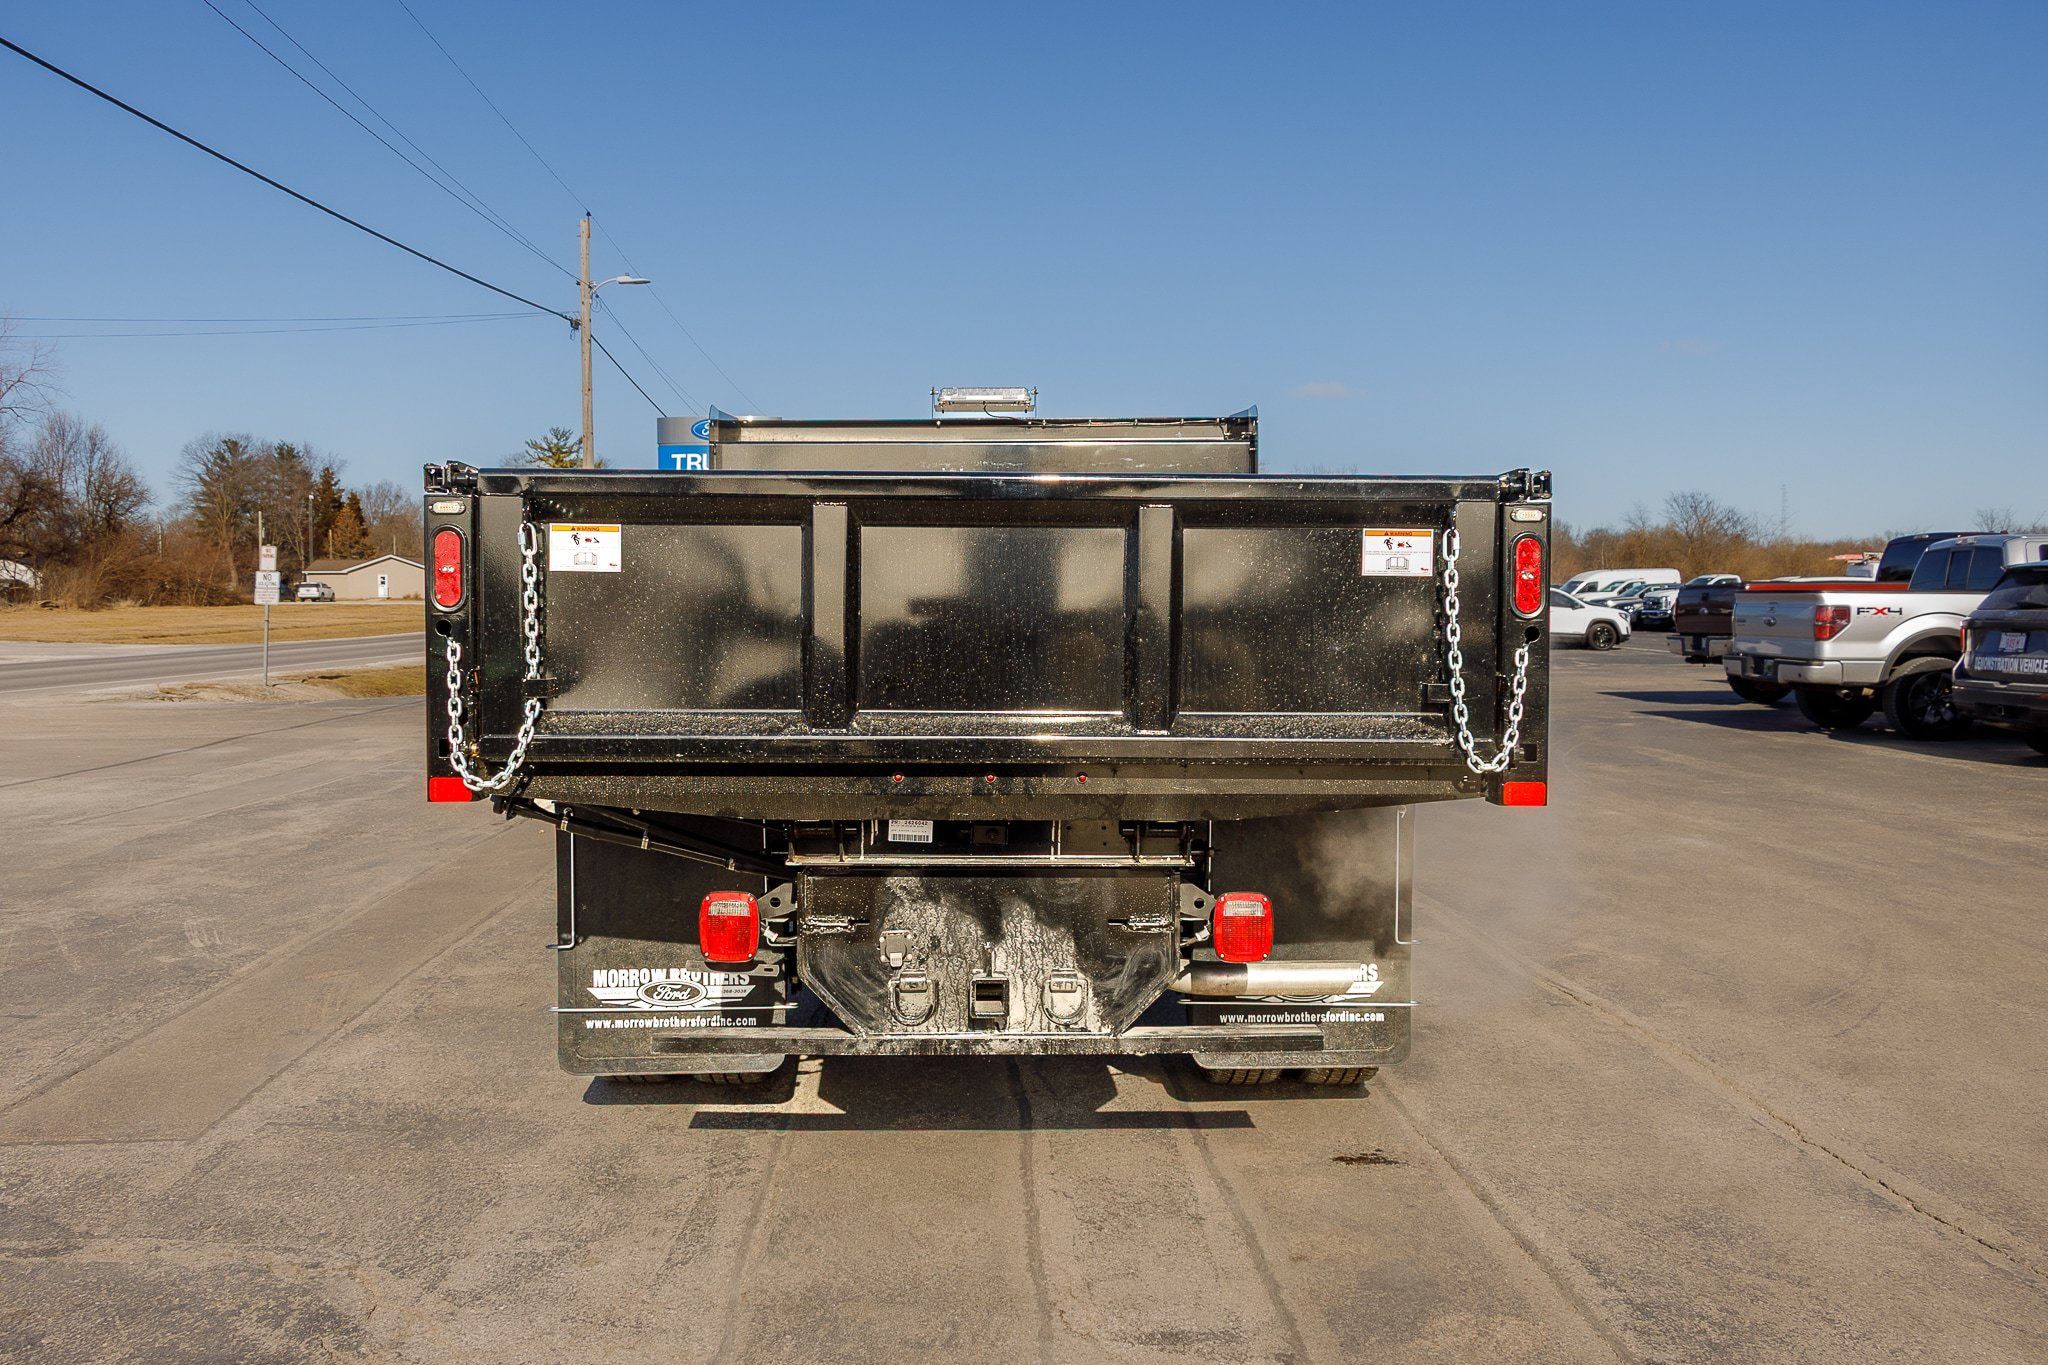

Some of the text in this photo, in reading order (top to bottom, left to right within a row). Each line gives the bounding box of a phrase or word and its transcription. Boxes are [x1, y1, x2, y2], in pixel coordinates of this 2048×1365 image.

[263, 573, 272, 581] NO
[1856, 607, 1903, 616] FX4
[1974, 656, 2048, 675] DEMONSTRATION VEHICLE
[593, 968, 750, 988] MORROW BROTHERS
[652, 984, 690, 1001] Ford
[585, 1015, 757, 1030] www.morrowbrothersfordinc.com
[1219, 1011, 1385, 1023] www.morrowbrothersfordinc.com
